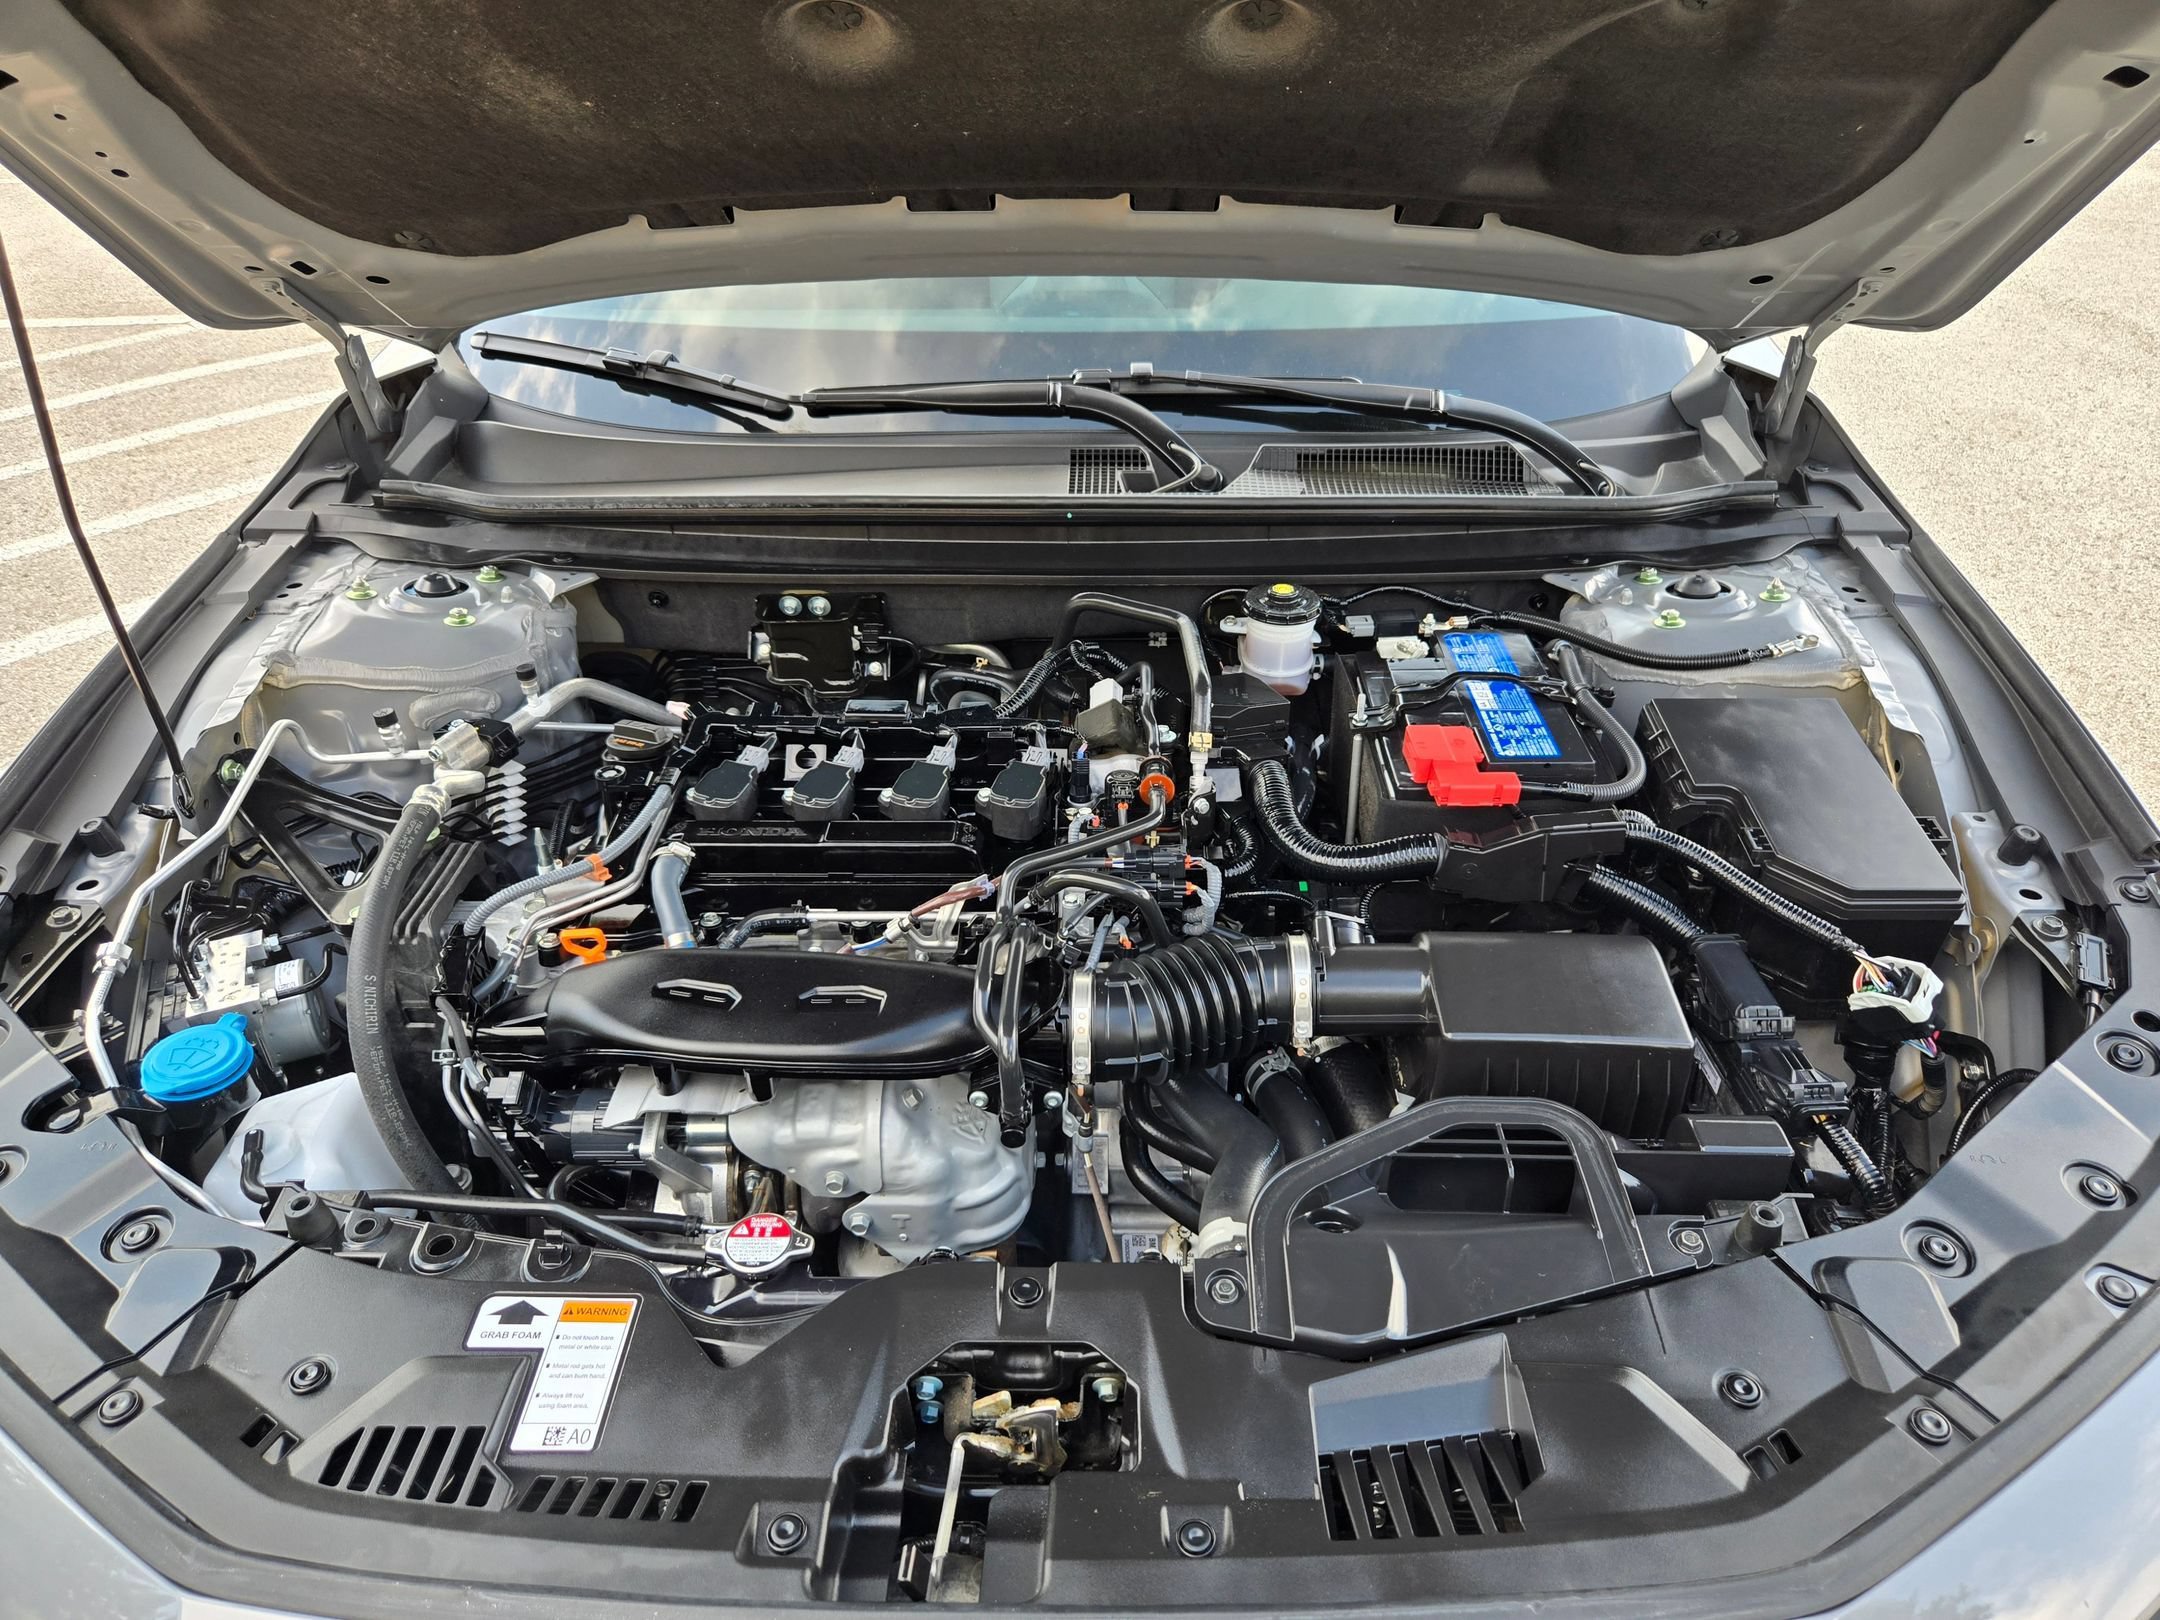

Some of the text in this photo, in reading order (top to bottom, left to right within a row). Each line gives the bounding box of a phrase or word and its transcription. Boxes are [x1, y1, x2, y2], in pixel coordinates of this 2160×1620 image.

[696, 826, 808, 837] HONDA
[576, 1307, 628, 1316] WARNING
[480, 1331, 541, 1339] GRAB FOAM
[566, 1427, 591, 1444] A0
